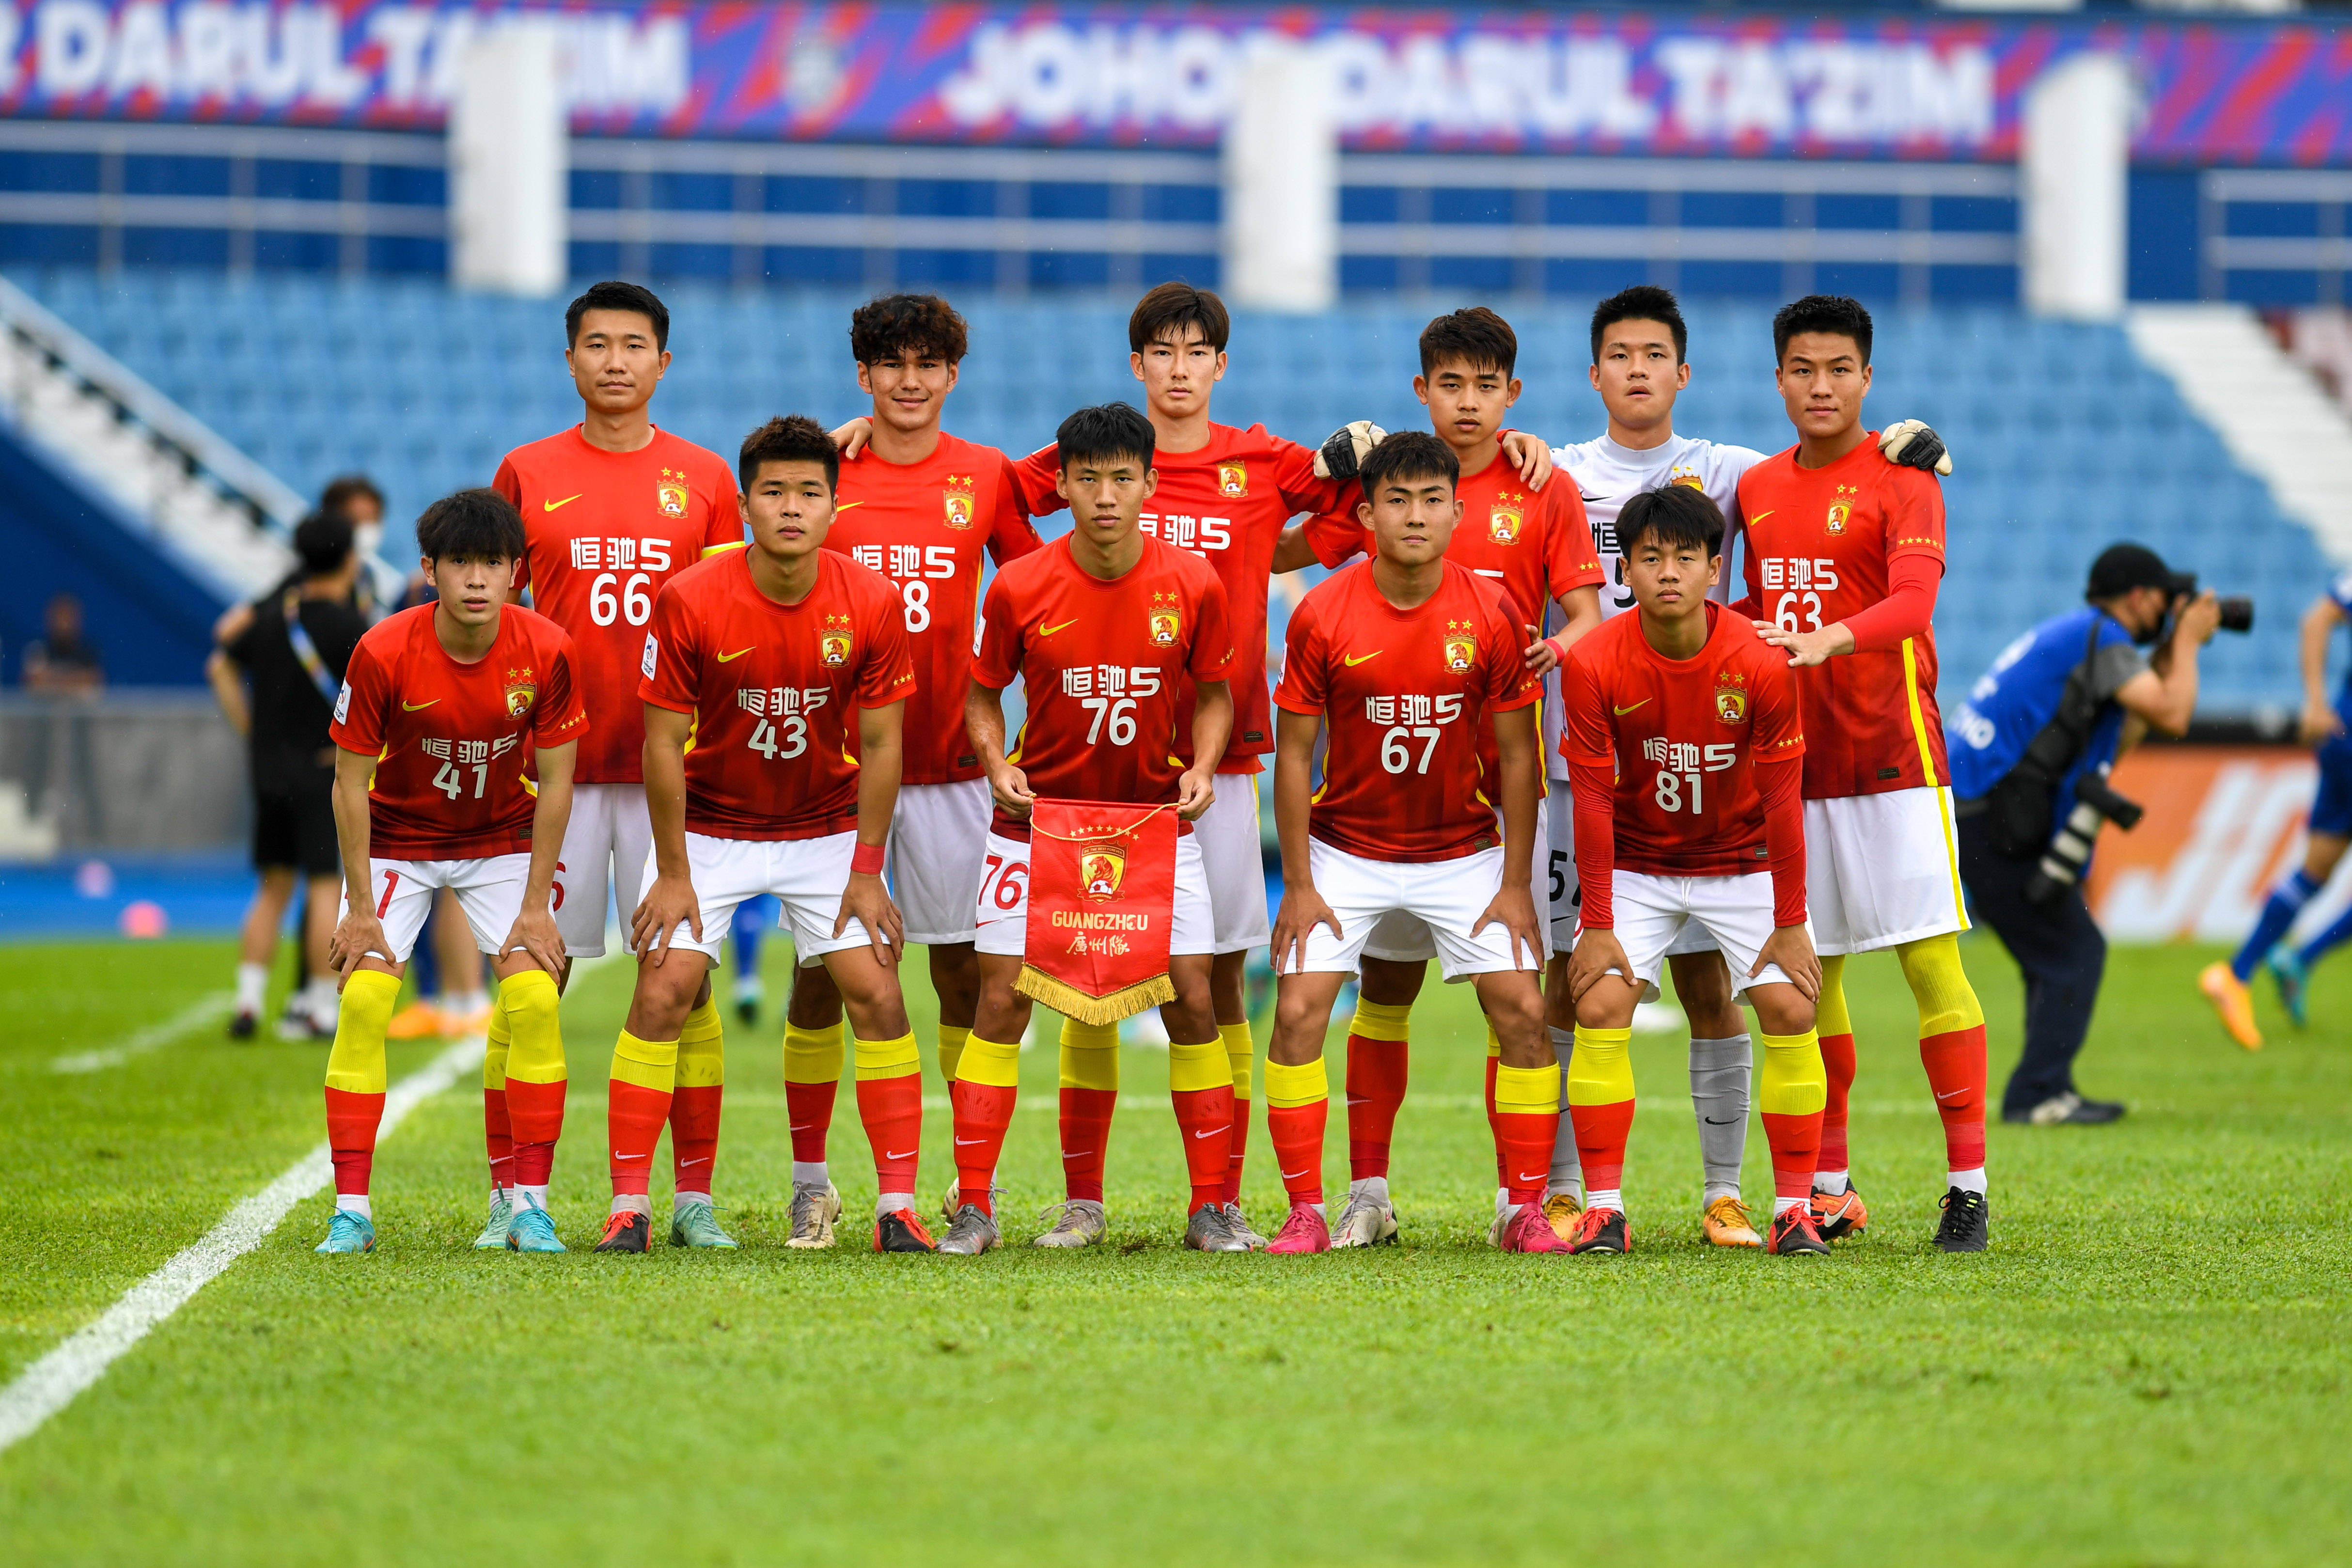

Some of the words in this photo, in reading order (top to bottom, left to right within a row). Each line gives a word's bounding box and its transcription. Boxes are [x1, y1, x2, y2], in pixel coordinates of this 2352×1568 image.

[38, 2, 364, 106] DARUL
[570, 537, 671, 571] 恒驰5
[1761, 558, 1838, 590] 恒驰5
[590, 573, 651, 626] 66
[891, 580, 930, 633] 8
[1775, 591, 1823, 633] 63
[1063, 664, 1160, 697] 恒驰5
[738, 687, 830, 717] 恒驰5
[1082, 698, 1137, 746] 76
[1366, 693, 1464, 725] 恒驰5
[422, 731, 517, 764] 恒驰5
[748, 716, 807, 760] 43
[1381, 726, 1441, 774] 67
[432, 761, 487, 800] 41
[1655, 770, 1702, 814] 81
[978, 855, 1029, 909] 76
[1052, 910, 1148, 931] GUANGZHOU
